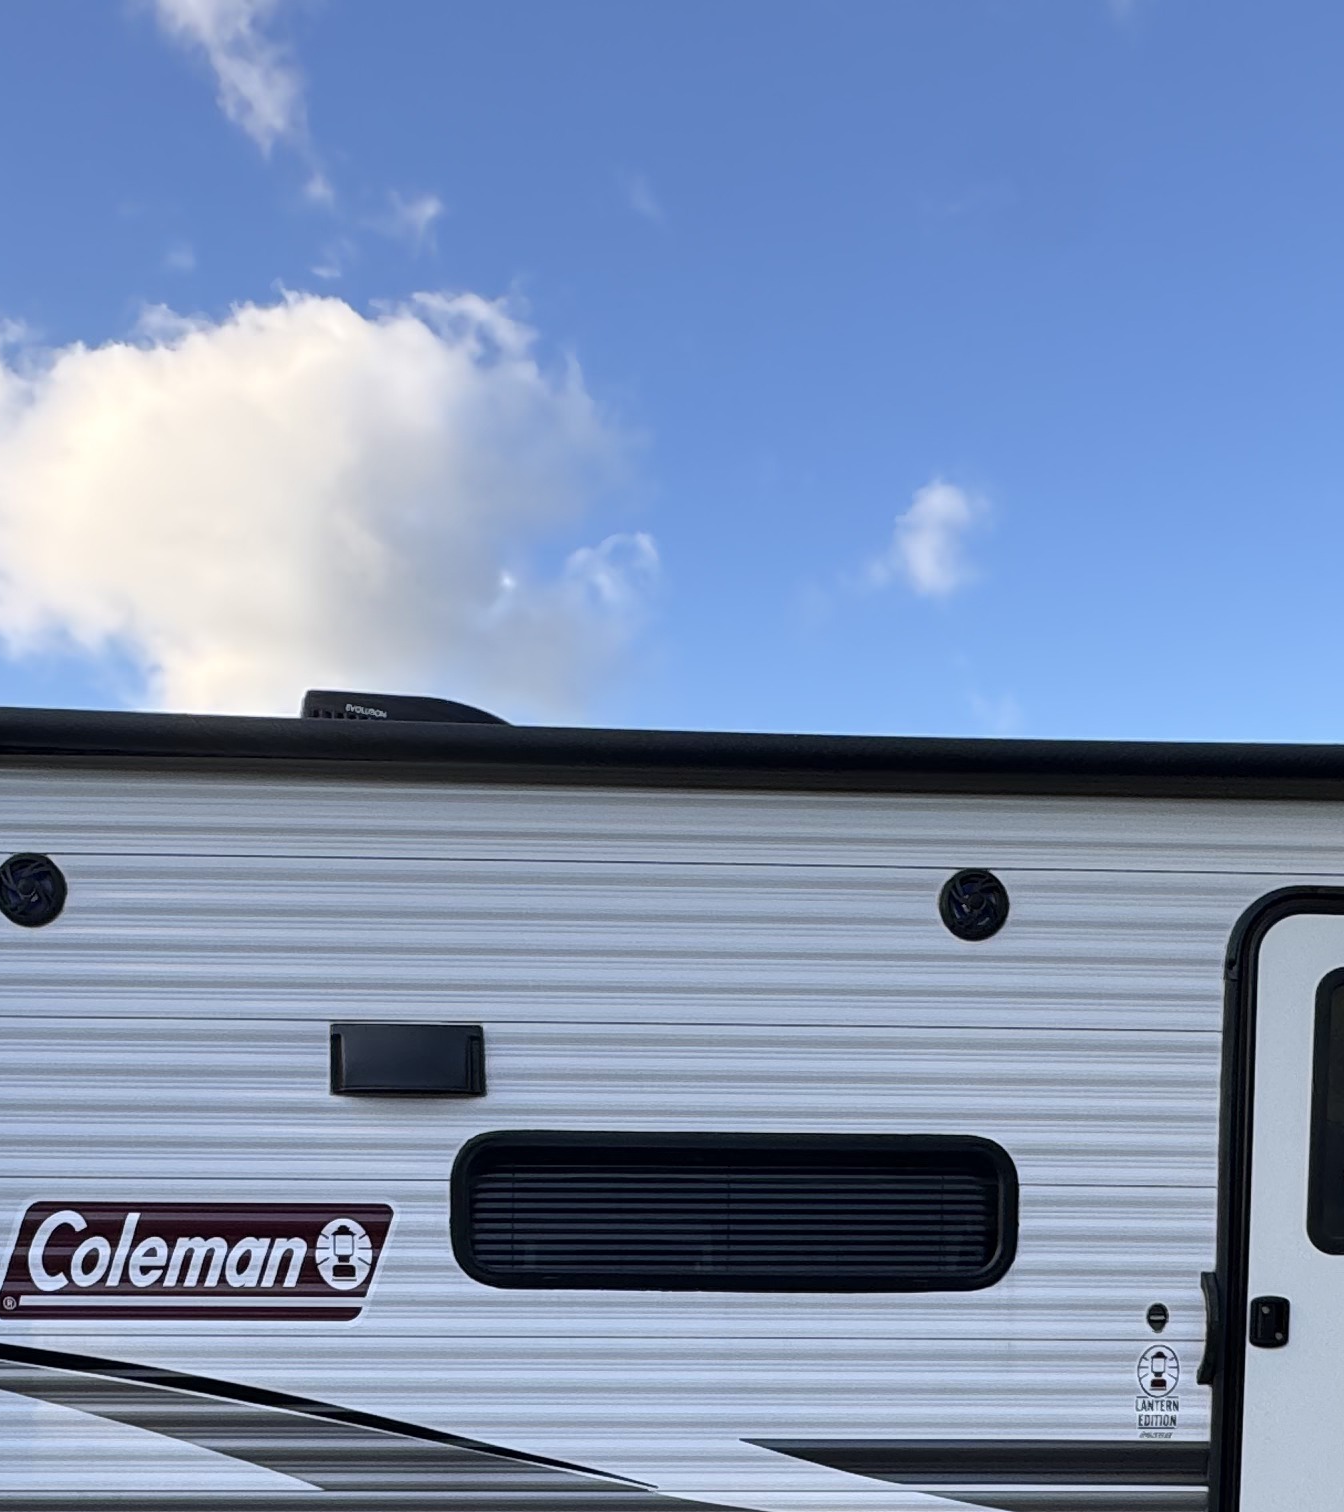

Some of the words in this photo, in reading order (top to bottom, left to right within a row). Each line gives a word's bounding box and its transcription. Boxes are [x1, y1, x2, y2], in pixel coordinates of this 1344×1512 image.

[28, 1209, 308, 1292] Coleman
[1135, 1399, 1179, 1412] LANTERN
[1138, 1414, 1177, 1427] EDITION
